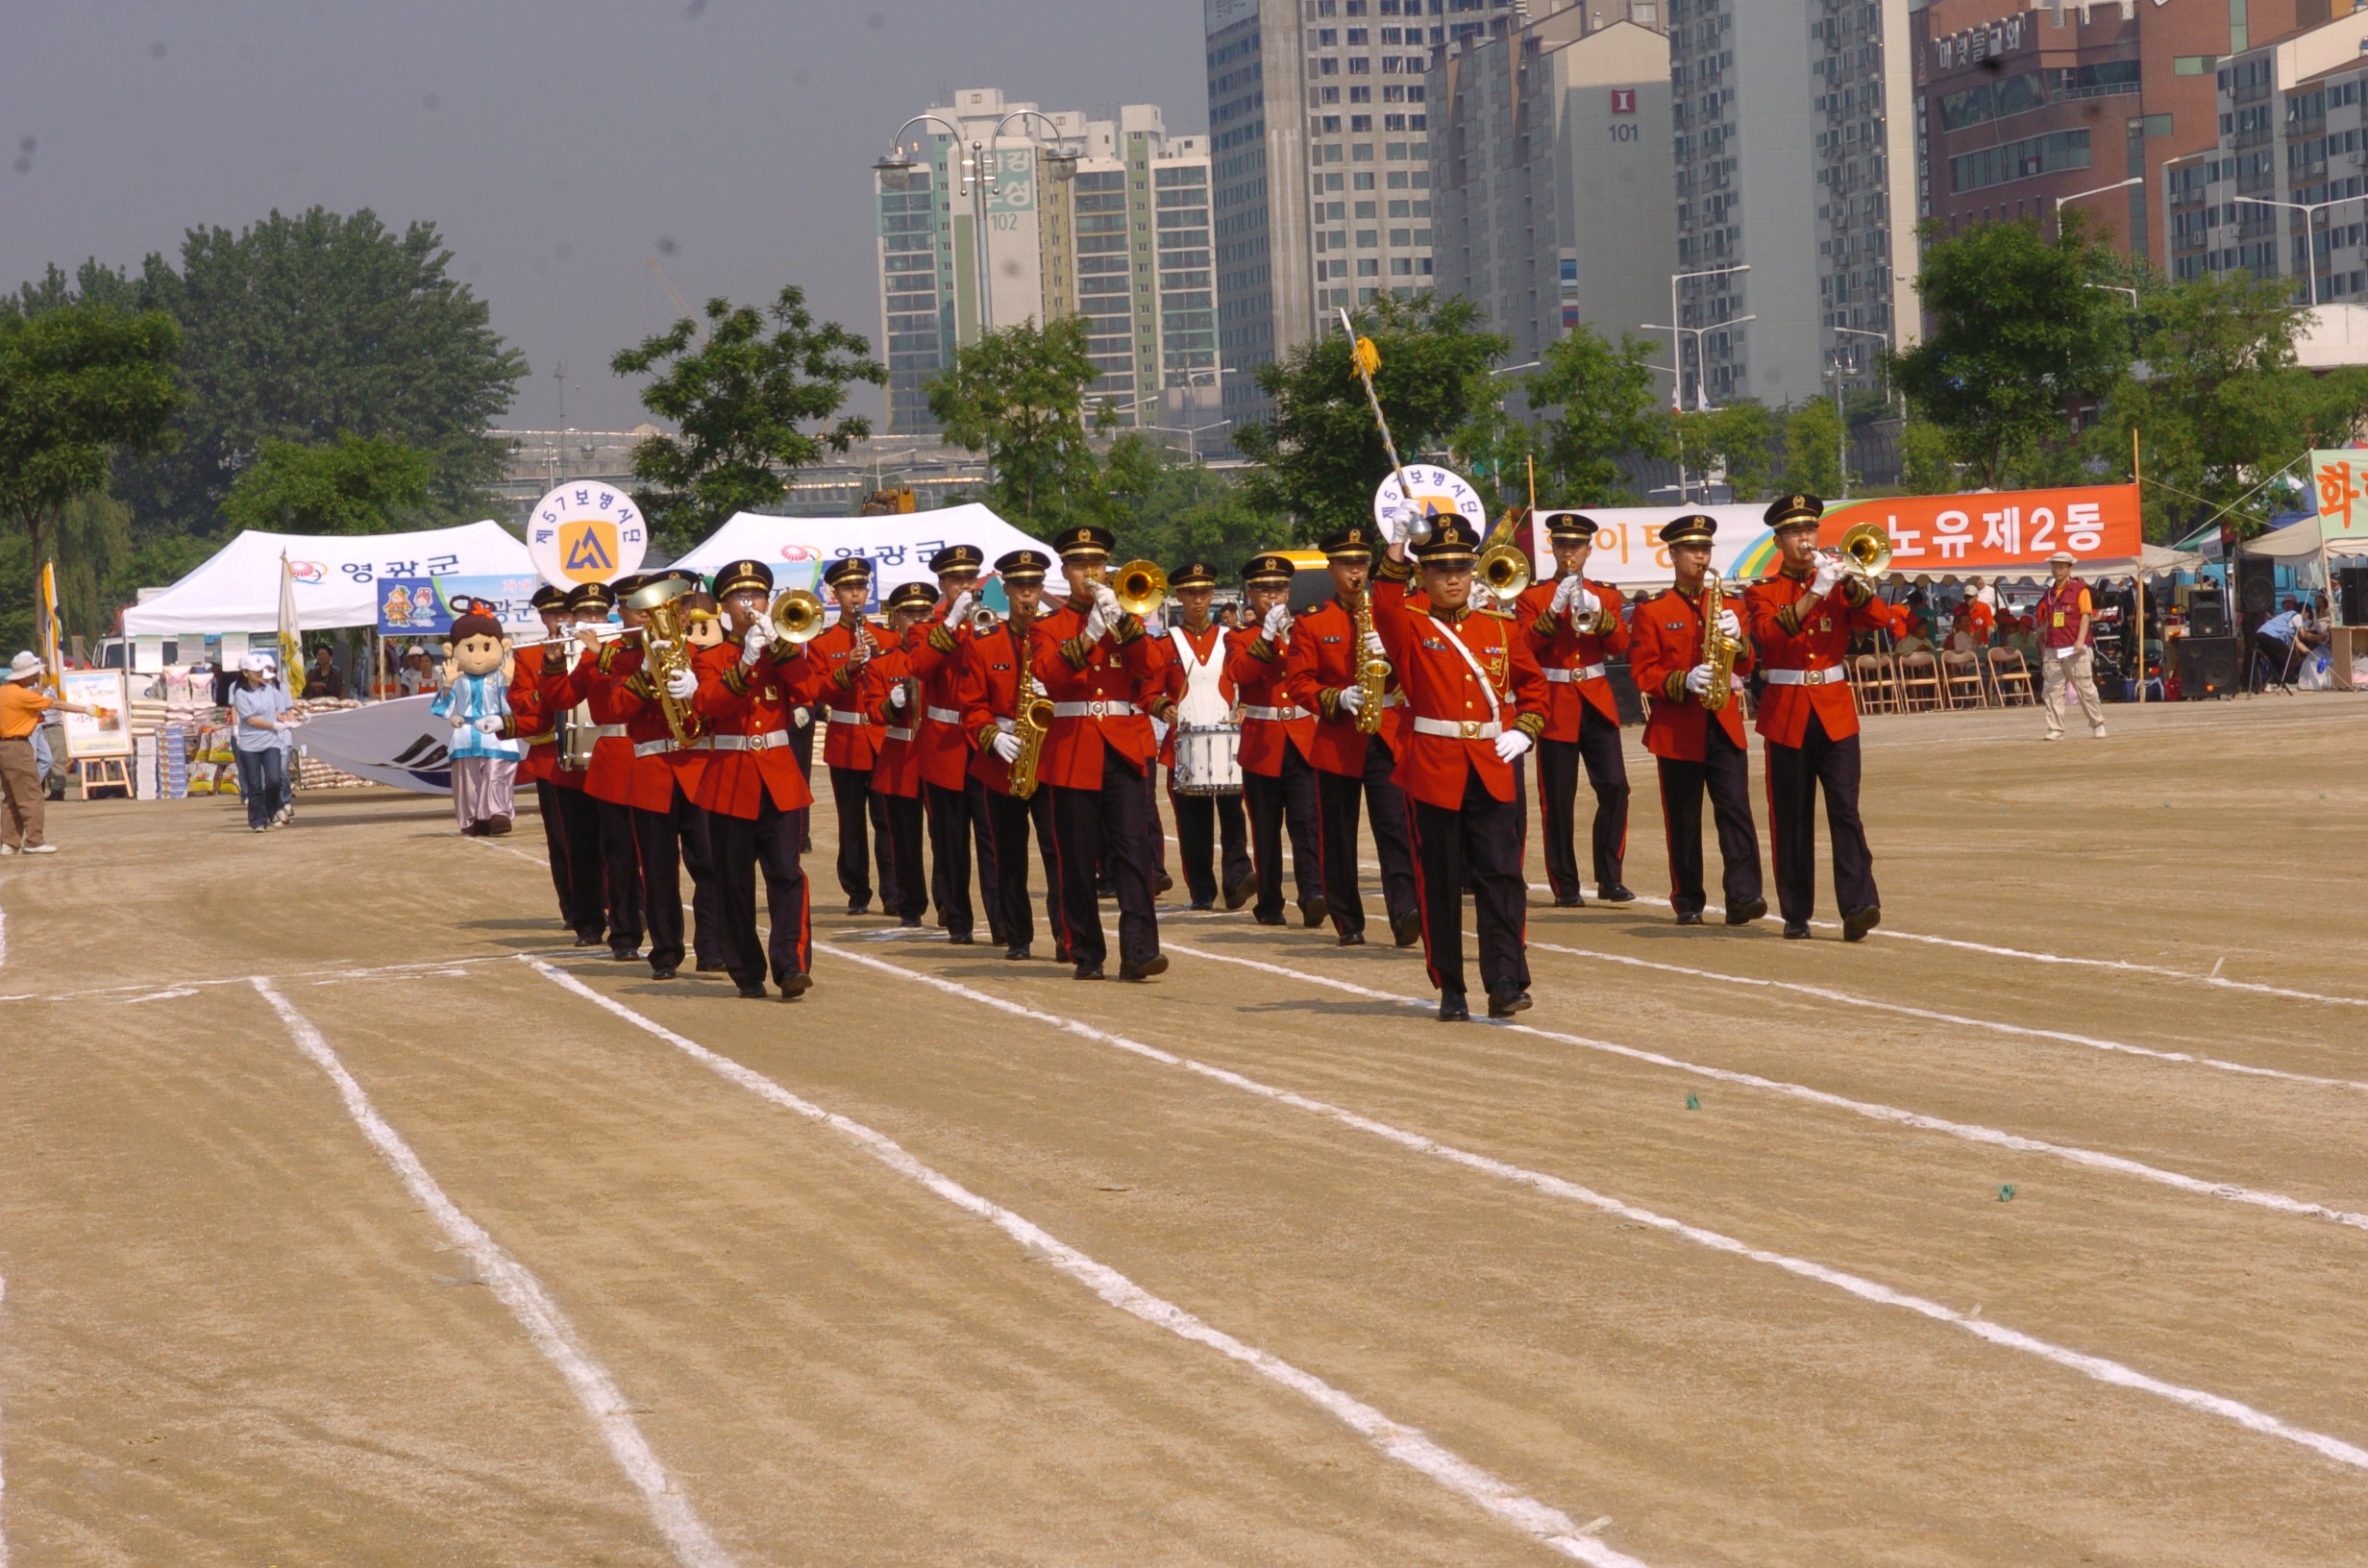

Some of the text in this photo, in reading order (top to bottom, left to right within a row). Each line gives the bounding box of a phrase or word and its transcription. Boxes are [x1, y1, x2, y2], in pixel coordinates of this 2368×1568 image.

[1608, 123, 1638, 142] 101
[991, 212, 1018, 231] 102
[1381, 469, 1478, 520] 제5보병사단
[2315, 461, 2368, 529] 화
[1887, 502, 2104, 558] 노유제2동
[341, 554, 459, 583] 영광군
